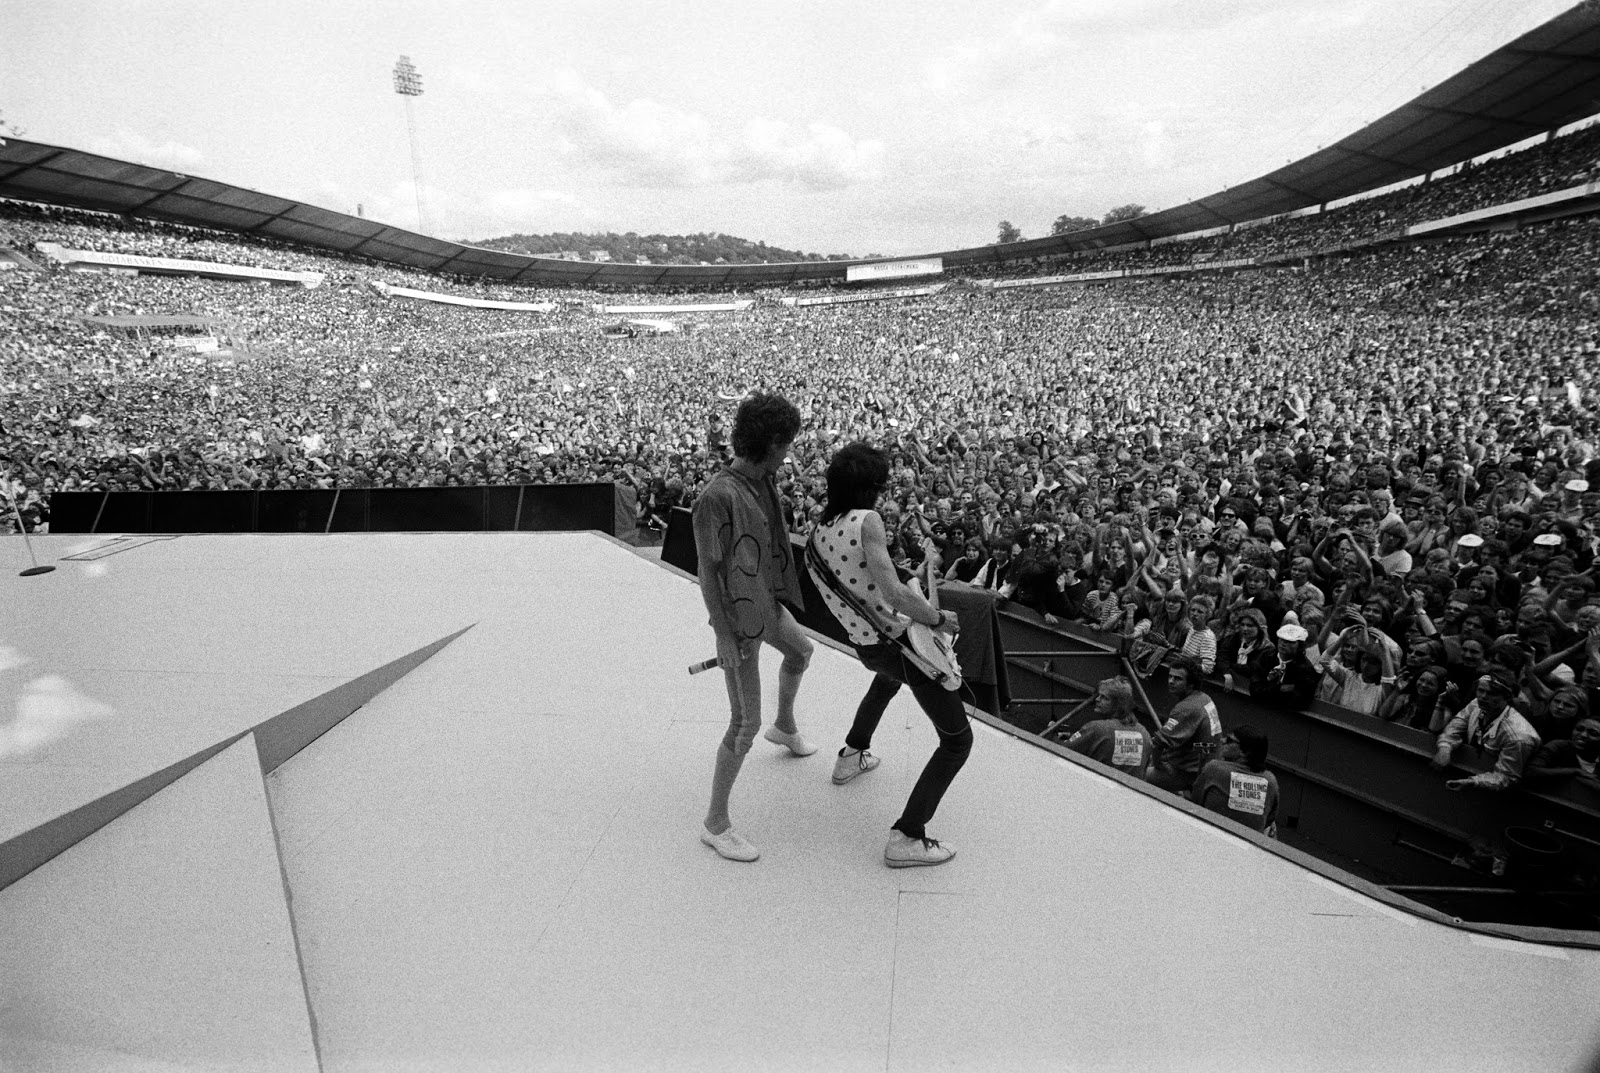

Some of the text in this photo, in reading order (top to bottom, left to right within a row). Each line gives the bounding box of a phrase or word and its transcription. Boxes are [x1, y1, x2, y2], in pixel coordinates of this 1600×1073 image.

[1124, 738, 1143, 746] ROLLING
[1120, 745, 1139, 753] STONES
[1231, 780, 1267, 792] THE ROLLING
[1238, 790, 1261, 799] STONES
